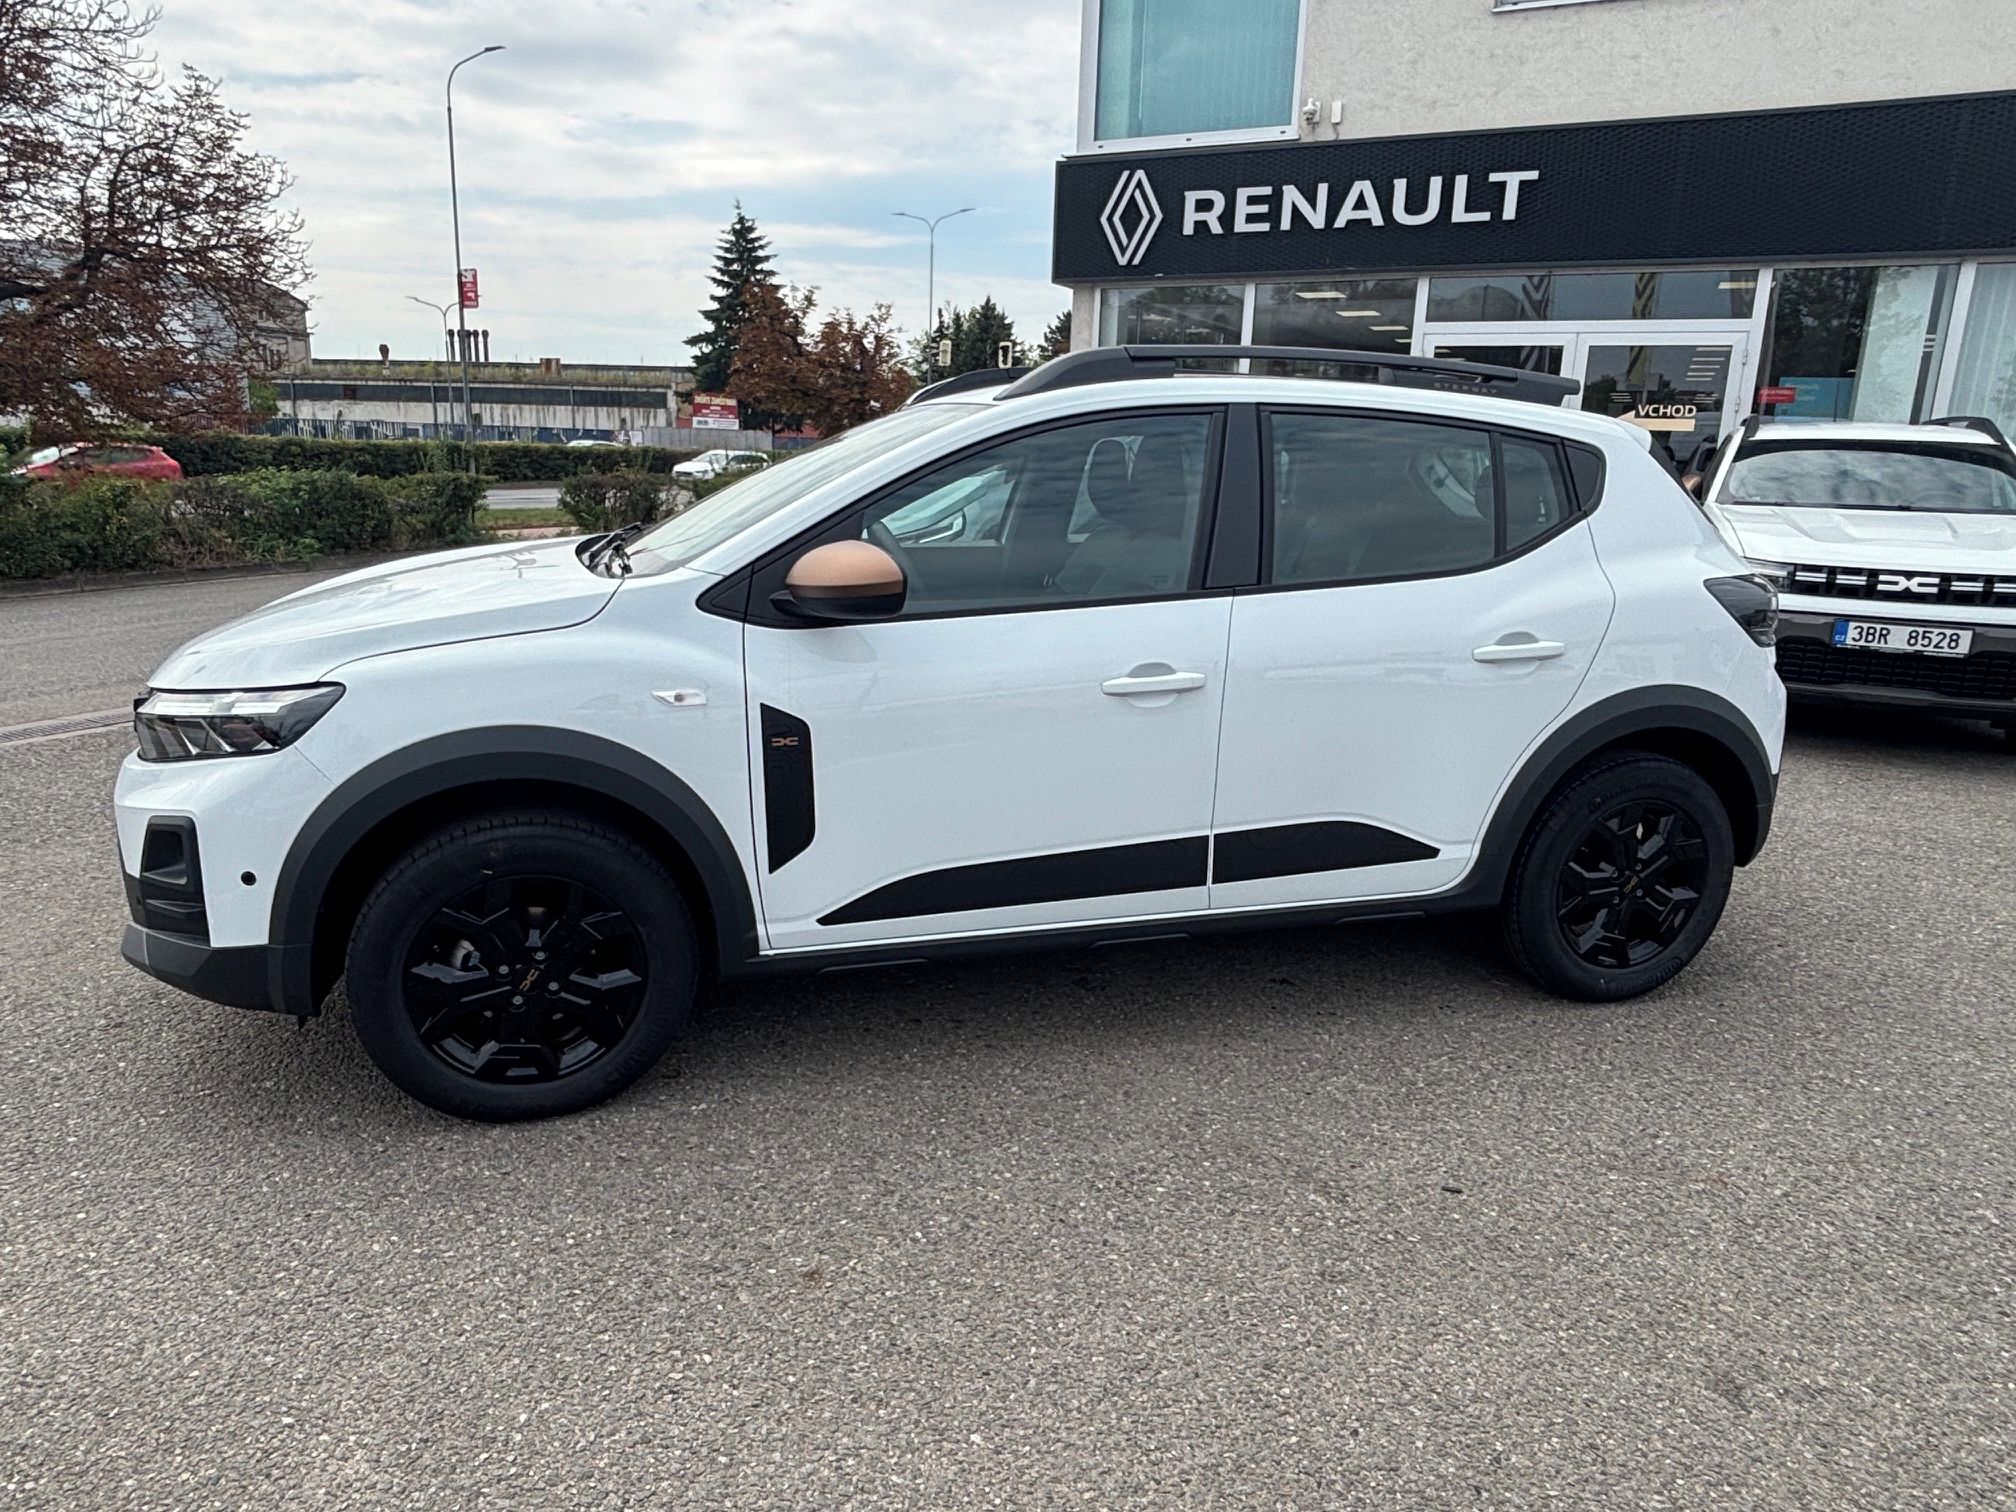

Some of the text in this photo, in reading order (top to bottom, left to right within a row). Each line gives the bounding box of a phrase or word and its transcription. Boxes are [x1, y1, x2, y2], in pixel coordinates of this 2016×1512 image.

[1182, 170, 1540, 236] RENAULT
[1637, 404, 1697, 418] VCHOD
[1851, 625, 1961, 650] 3BR 8528
